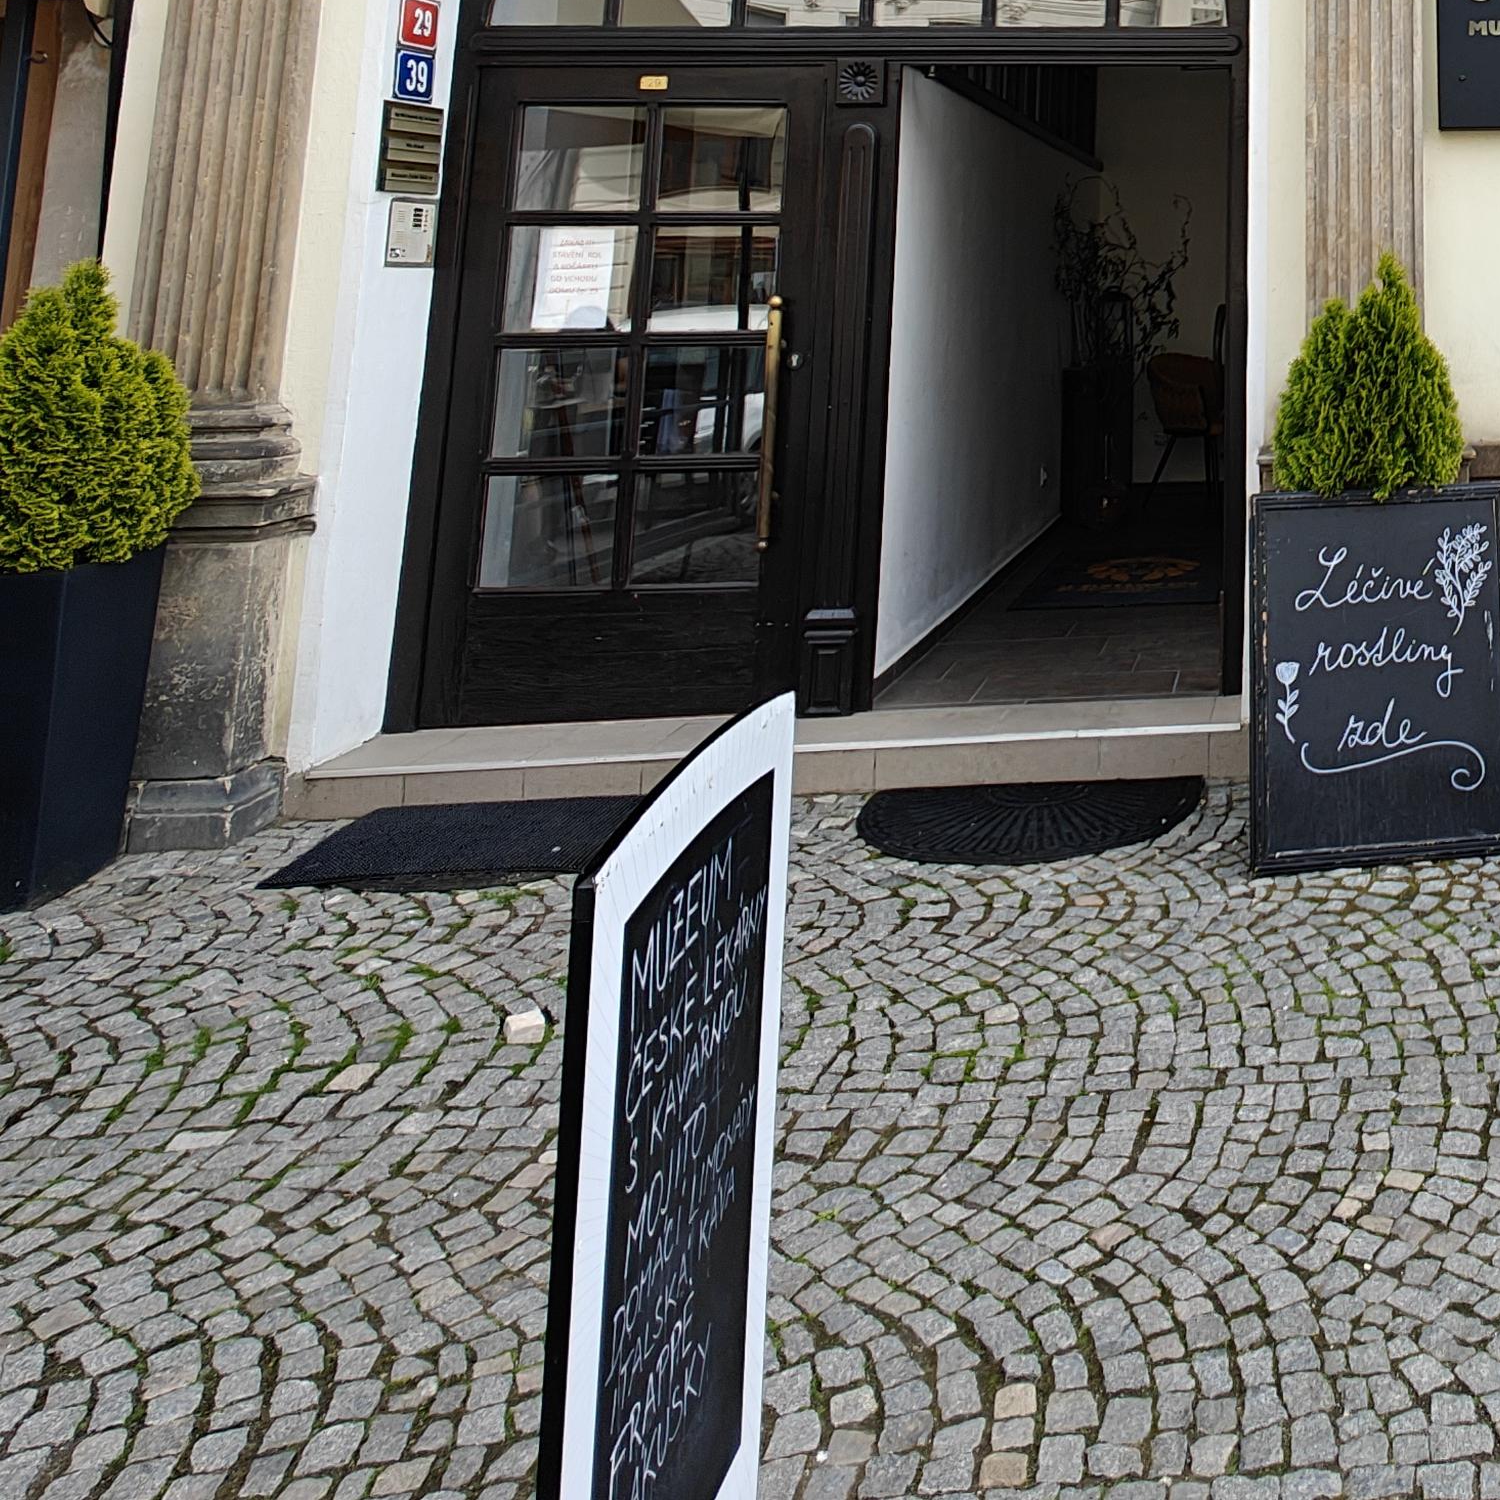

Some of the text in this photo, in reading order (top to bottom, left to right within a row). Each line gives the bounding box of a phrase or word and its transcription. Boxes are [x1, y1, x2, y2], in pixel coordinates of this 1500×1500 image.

[412, 7, 432, 36] 29
[406, 59, 428, 93] 39
[1295, 546, 1436, 611] Léčivé
[1309, 628, 1464, 698] rostliny
[1338, 698, 1428, 752] zde
[631, 836, 733, 1032] MUZEUM
[624, 1102, 707, 1280] MOJITO
[625, 1137, 638, 1194] S
